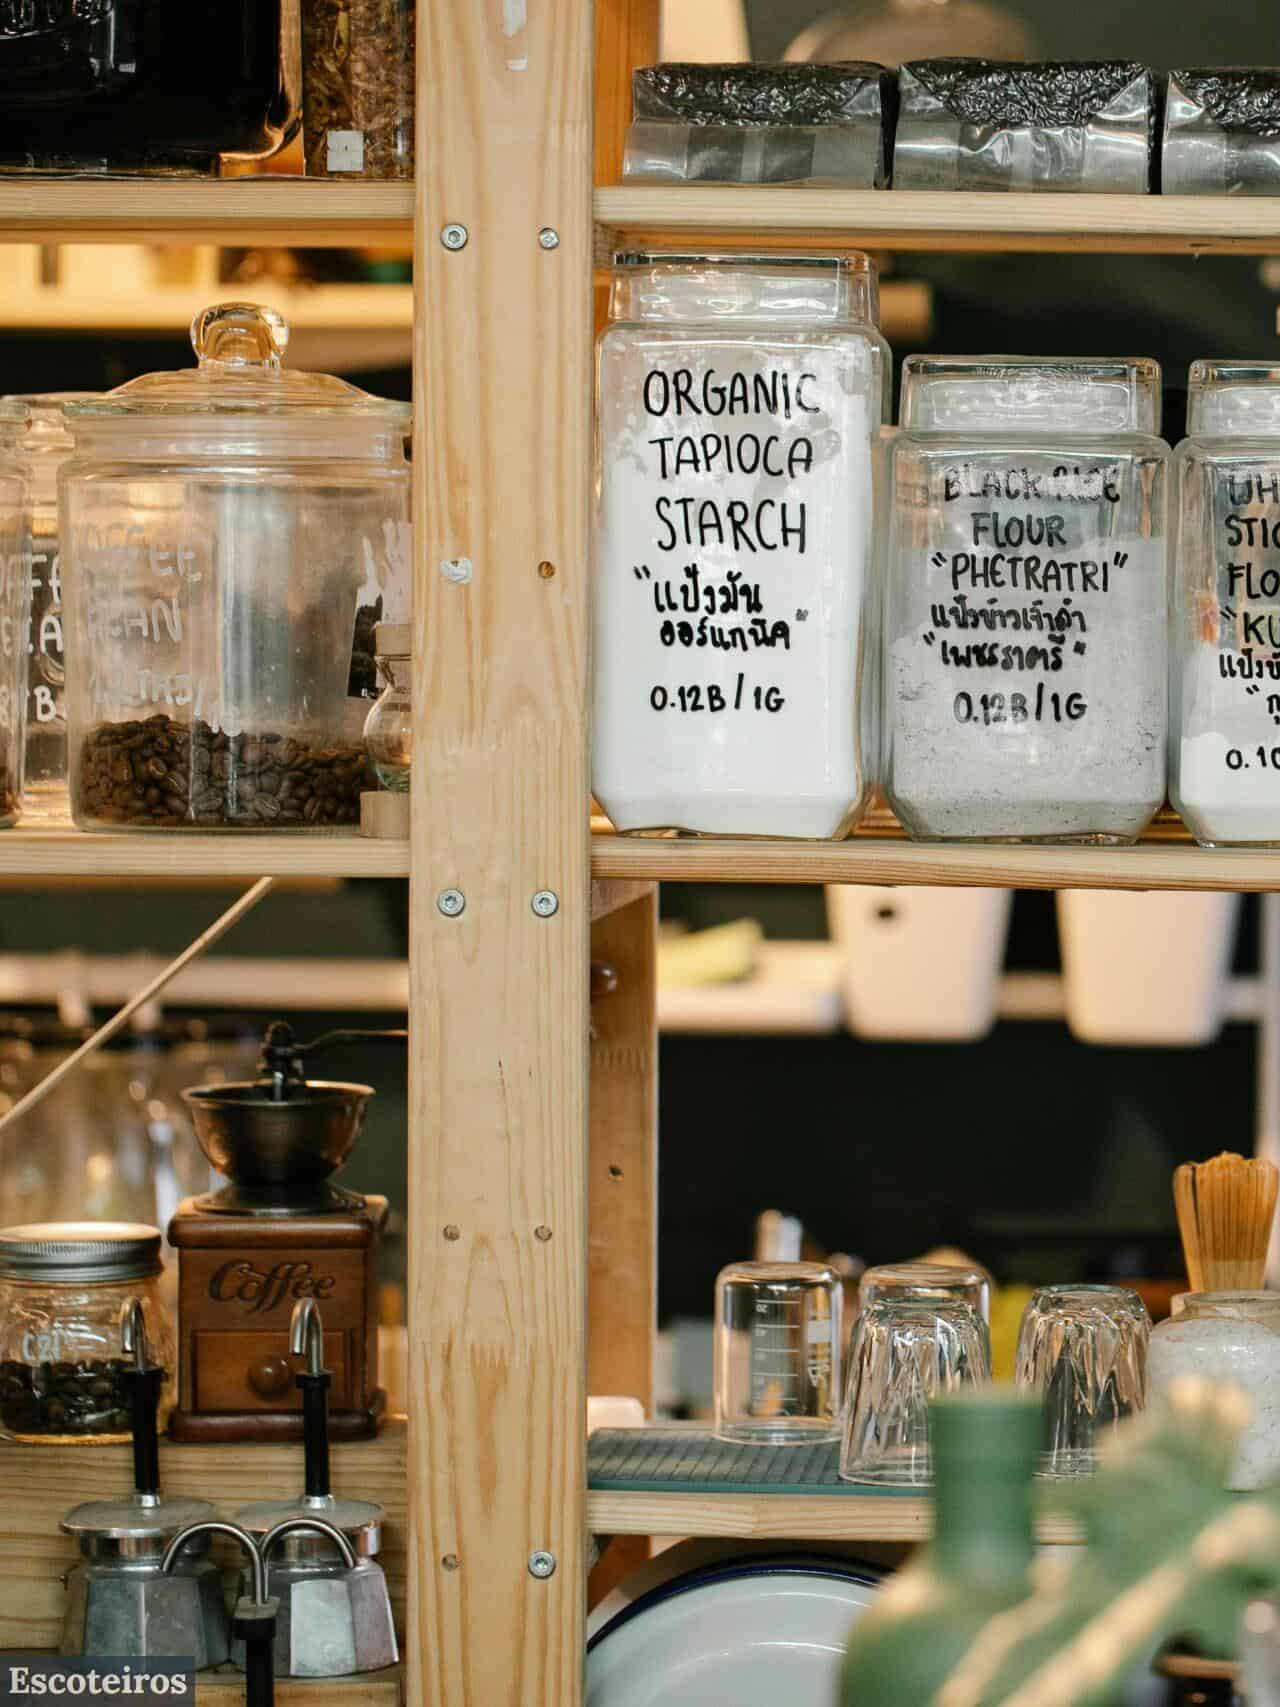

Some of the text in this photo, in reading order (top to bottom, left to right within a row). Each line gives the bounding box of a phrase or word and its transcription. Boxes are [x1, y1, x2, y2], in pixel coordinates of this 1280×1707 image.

[643, 369, 820, 418] ORGANIC
[648, 433, 812, 480] TAPIOCA
[655, 496, 805, 553] STARCH
[971, 512, 1067, 548] FLOUR
[208, 1258, 336, 1312] Coffee
